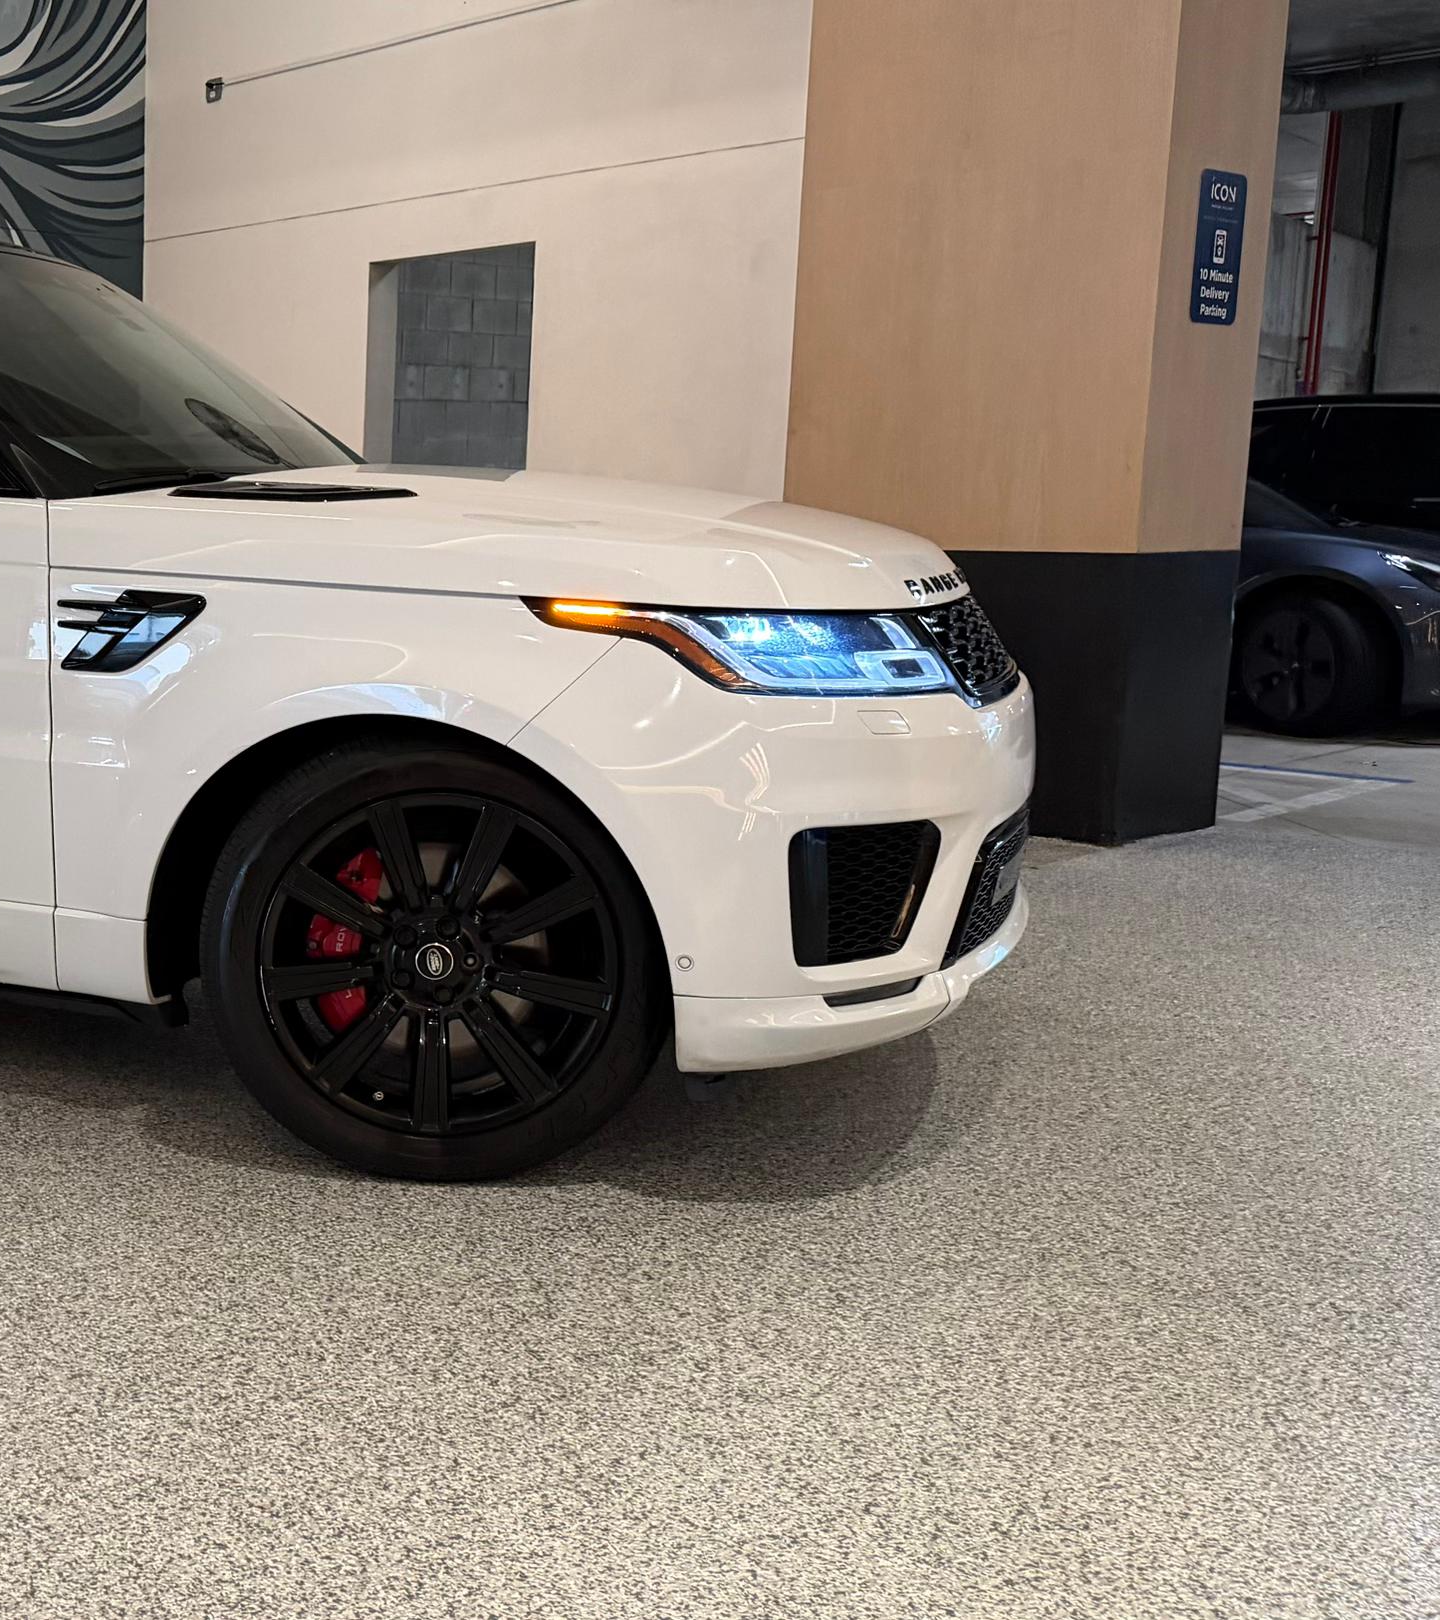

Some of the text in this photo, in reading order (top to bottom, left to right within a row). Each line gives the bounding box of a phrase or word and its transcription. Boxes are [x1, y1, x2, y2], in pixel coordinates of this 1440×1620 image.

[1200, 267, 1234, 284] 10 Minute
[1200, 285, 1230, 303] Delivery
[1200, 303, 1227, 320] Parking
[903, 572, 959, 598] RANGE
